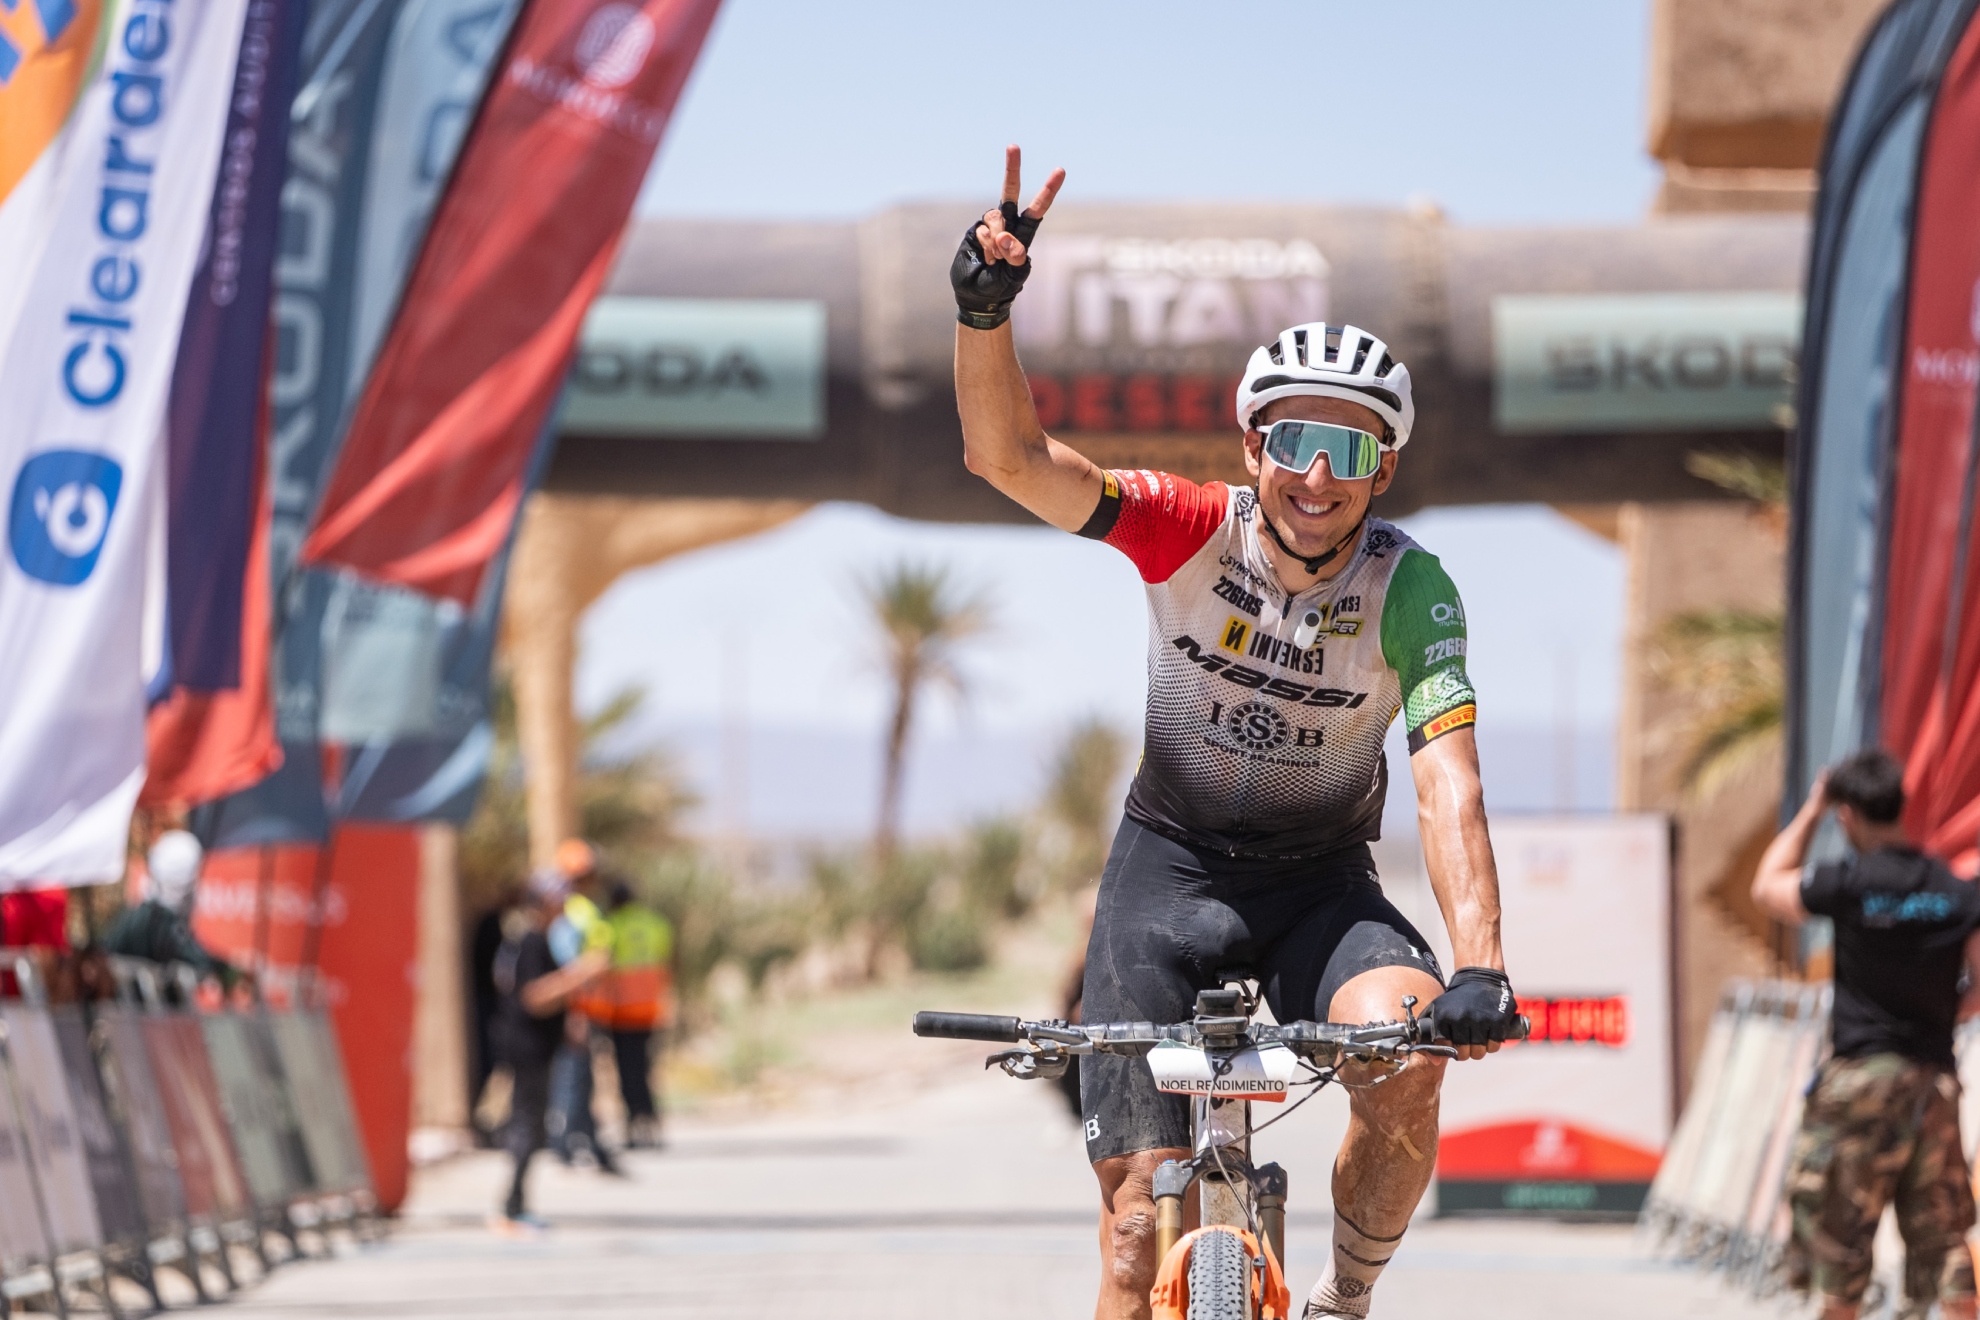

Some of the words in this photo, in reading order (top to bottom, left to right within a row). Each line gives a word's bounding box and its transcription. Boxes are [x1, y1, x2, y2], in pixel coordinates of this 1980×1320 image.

[62, 0, 173, 408] Clearde
[572, 342, 772, 398] ODA
[1545, 334, 1800, 394] SKOD
[1211, 575, 1263, 618] 226ERS
[1424, 637, 1467, 667] 226ER
[1203, 736, 1247, 758] SPORT
[1205, 1023, 1237, 1031] GARMIN
[1160, 1079, 1195, 1091] NOEL
[1196, 1079, 1285, 1092] RENDIMIENTO
